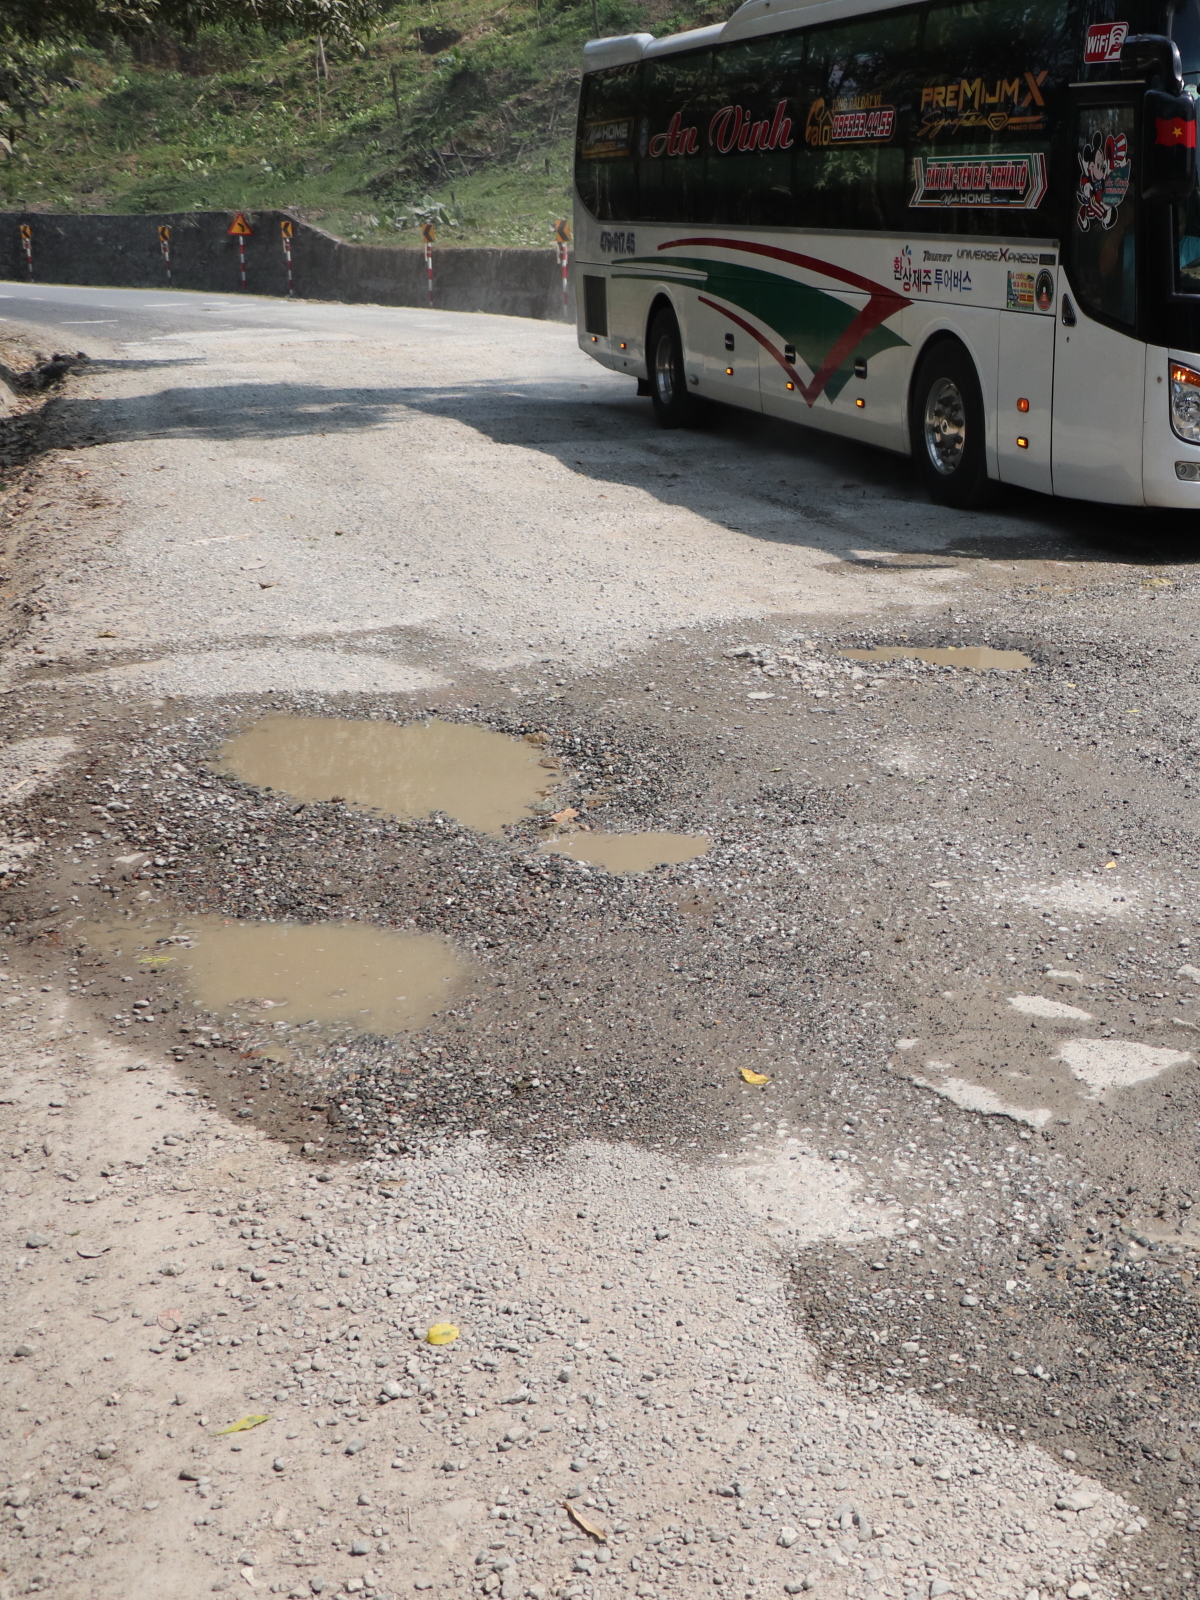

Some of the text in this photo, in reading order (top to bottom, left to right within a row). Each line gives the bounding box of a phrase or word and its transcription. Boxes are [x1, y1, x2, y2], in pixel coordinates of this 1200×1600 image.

[1087, 34, 1111, 53] WiFi
[649, 99, 794, 157] An Vinh
[960, 193, 991, 204] HOME
[934, 269, 972, 292] 투어버스
